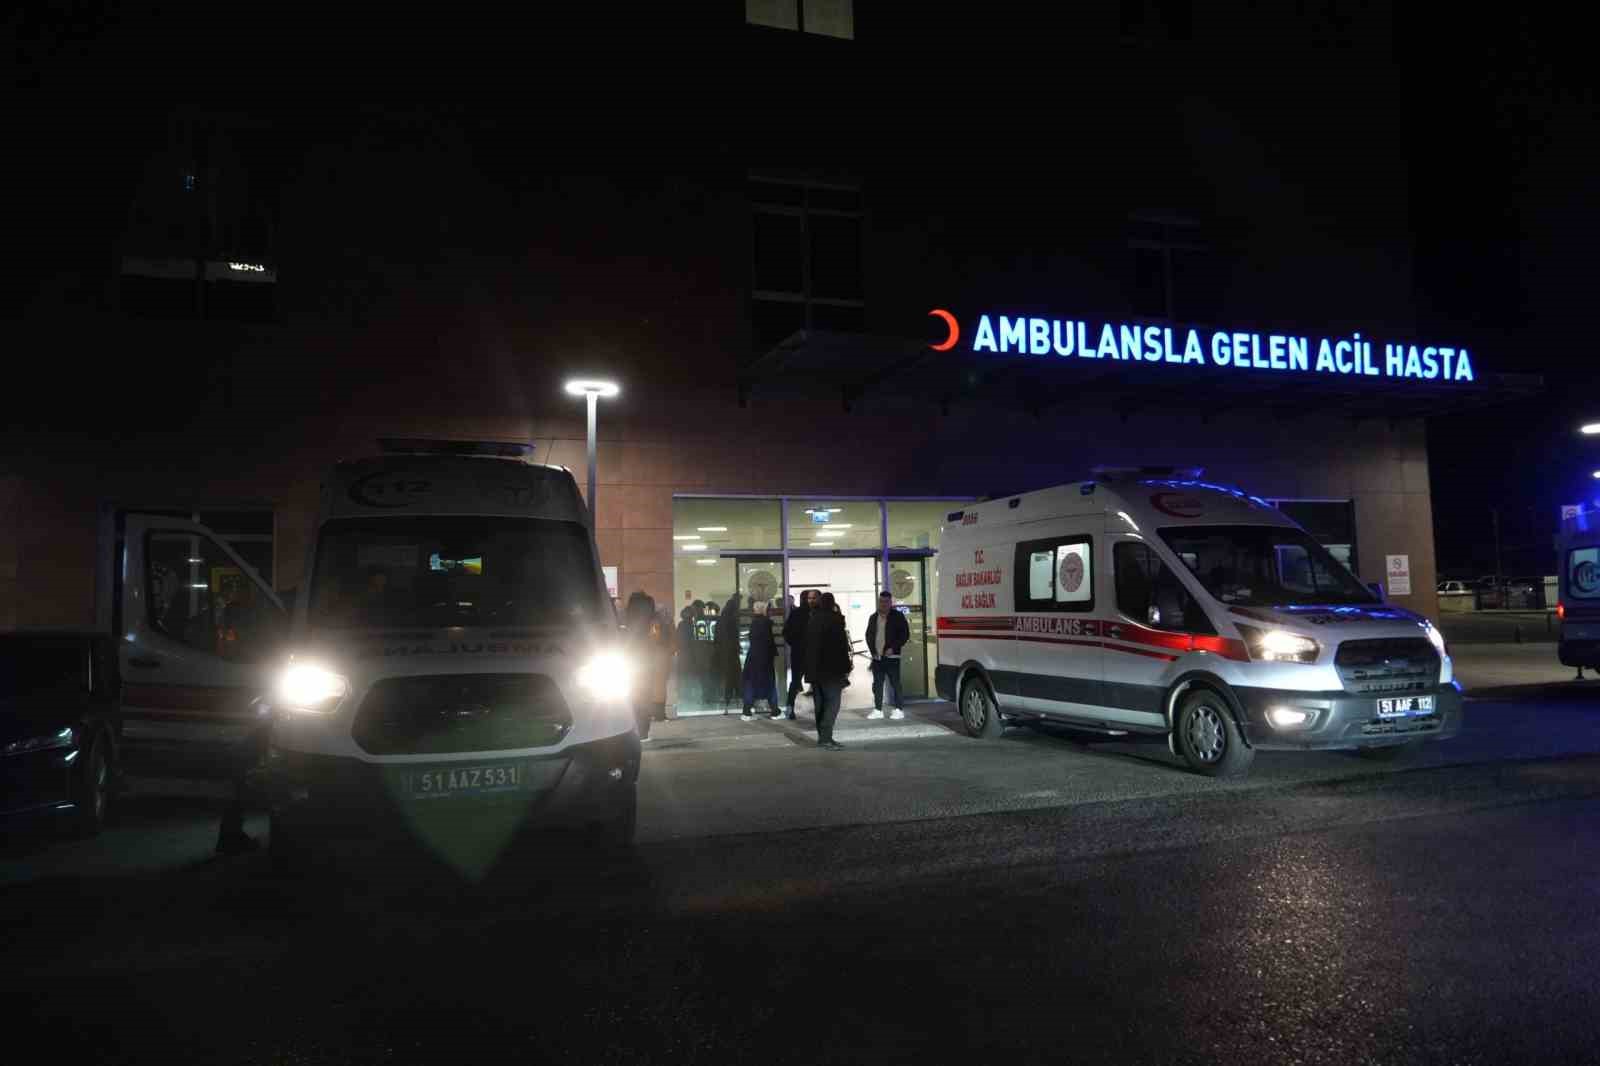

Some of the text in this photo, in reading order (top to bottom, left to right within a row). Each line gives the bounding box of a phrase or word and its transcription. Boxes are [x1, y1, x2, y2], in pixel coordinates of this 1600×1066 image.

[973, 314, 1474, 381] AMBULANSLA GELEN ACİL HASTA
[1015, 616, 1081, 634] AMBULANS
[421, 767, 517, 792] 51 AAZ 531
